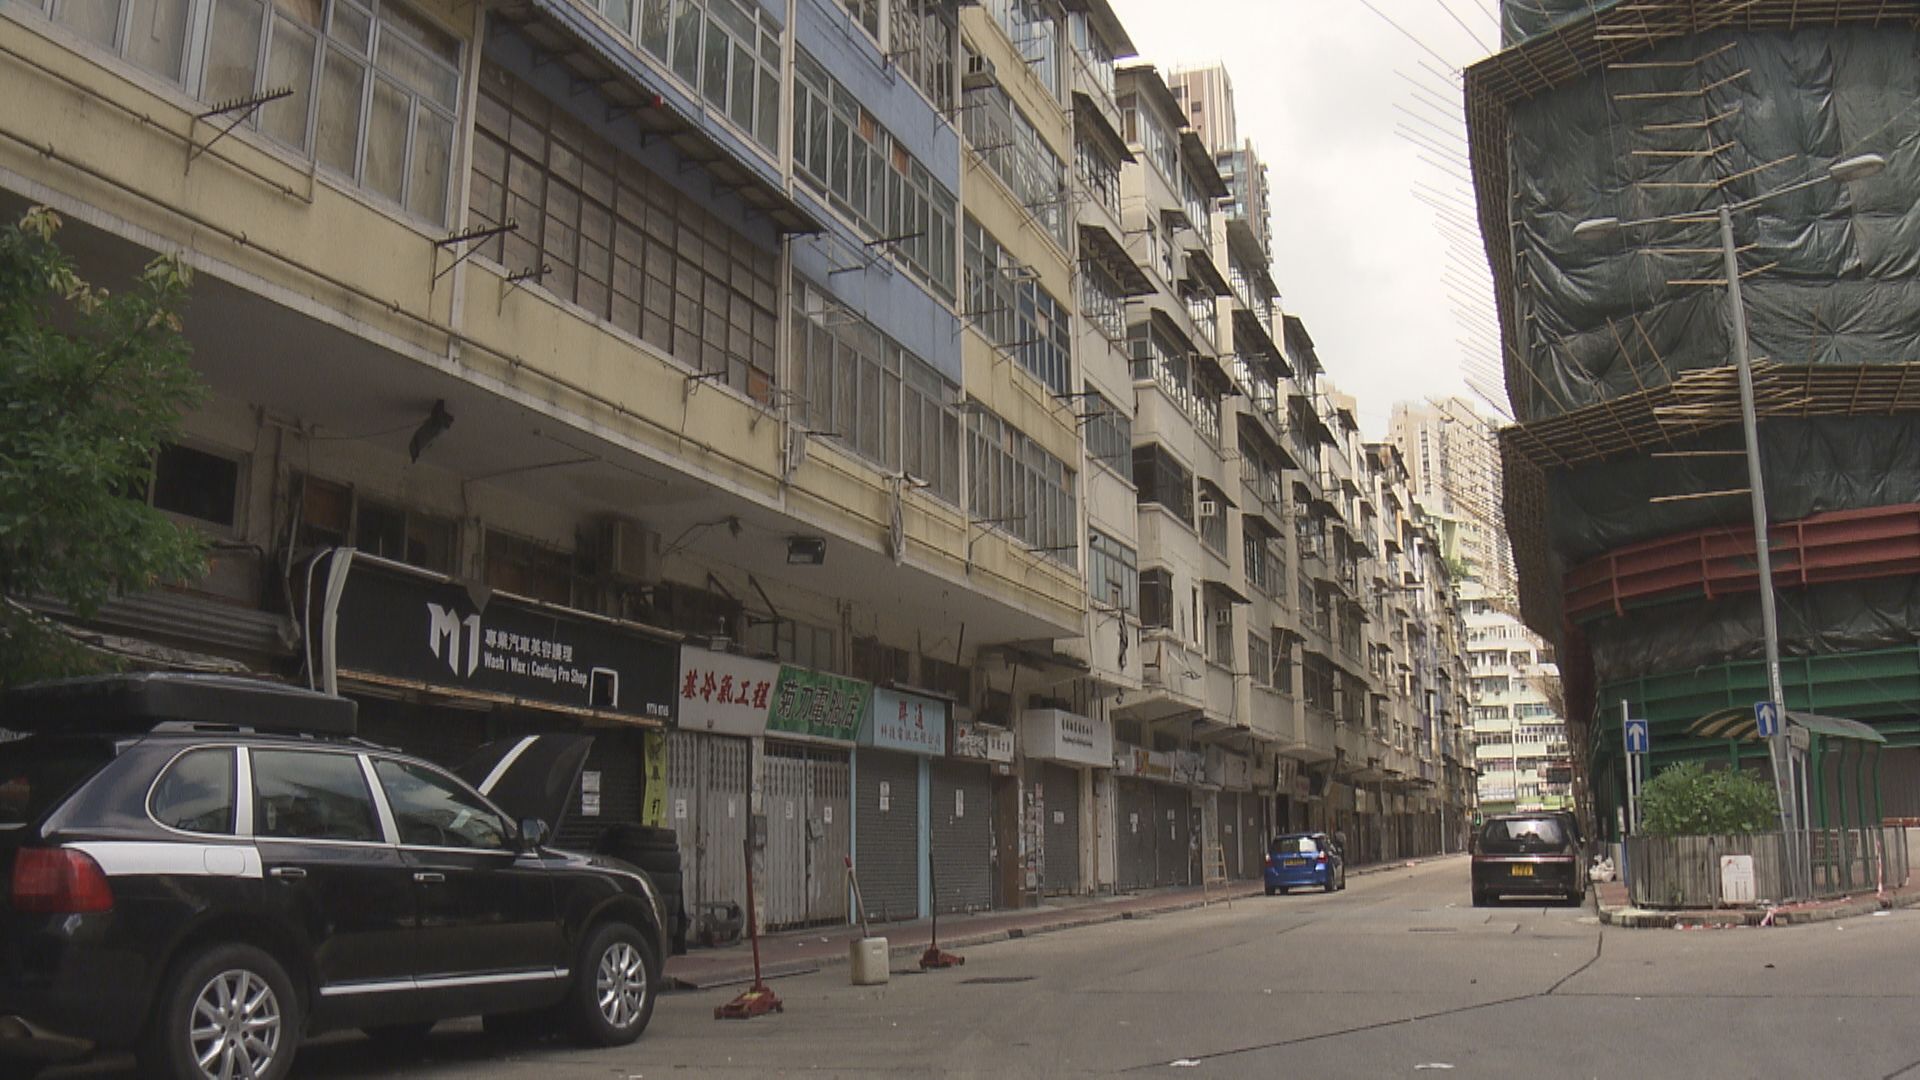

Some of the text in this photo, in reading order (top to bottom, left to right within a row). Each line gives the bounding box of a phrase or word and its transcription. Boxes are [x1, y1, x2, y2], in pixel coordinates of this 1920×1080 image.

[484, 652, 588, 688] Wash Wax Coating Pro Shop
